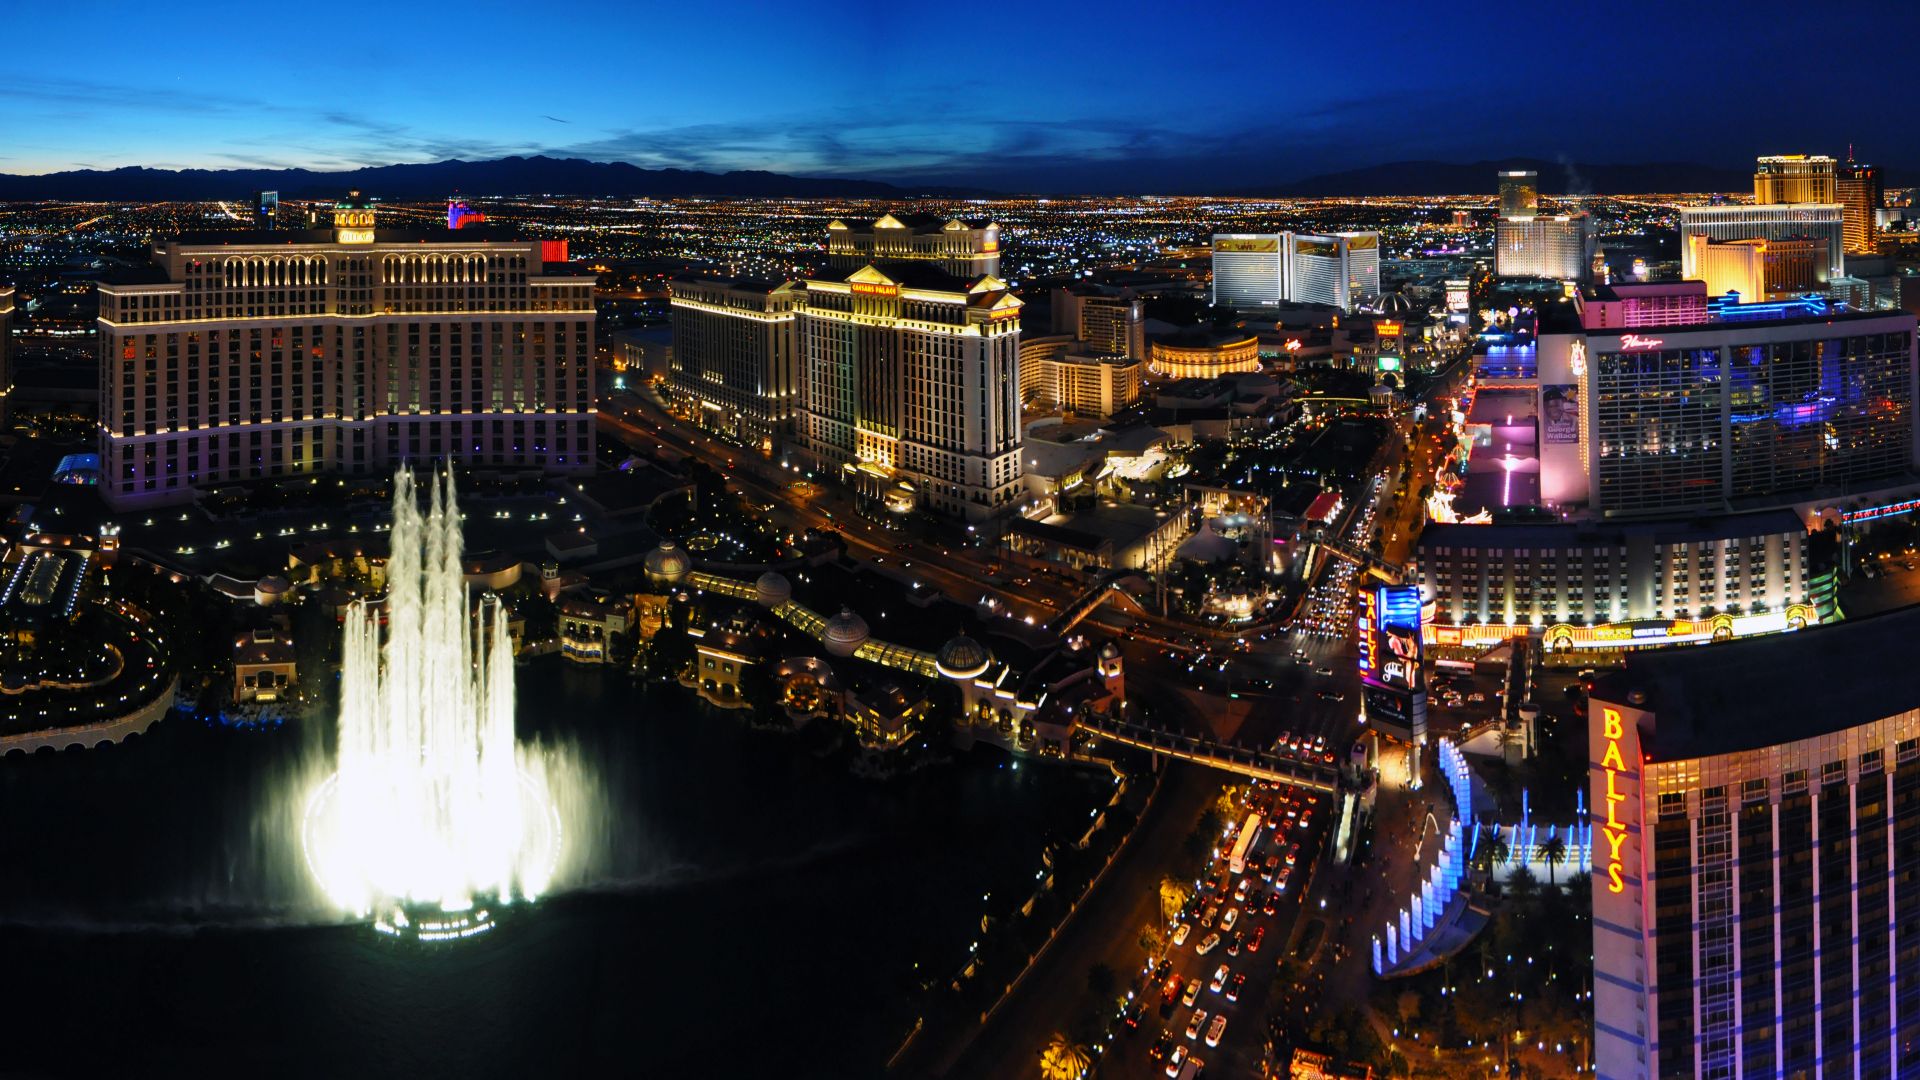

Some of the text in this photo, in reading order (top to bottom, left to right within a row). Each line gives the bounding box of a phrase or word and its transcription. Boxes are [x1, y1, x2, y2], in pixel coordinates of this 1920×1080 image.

[852, 283, 897, 295] CAESARS PALACE
[1620, 334, 1663, 350] Flamingo
[1547, 426, 1576, 434] George
[1366, 593, 1376, 670] BALLYS
[1601, 708, 1628, 894] BALLYS
